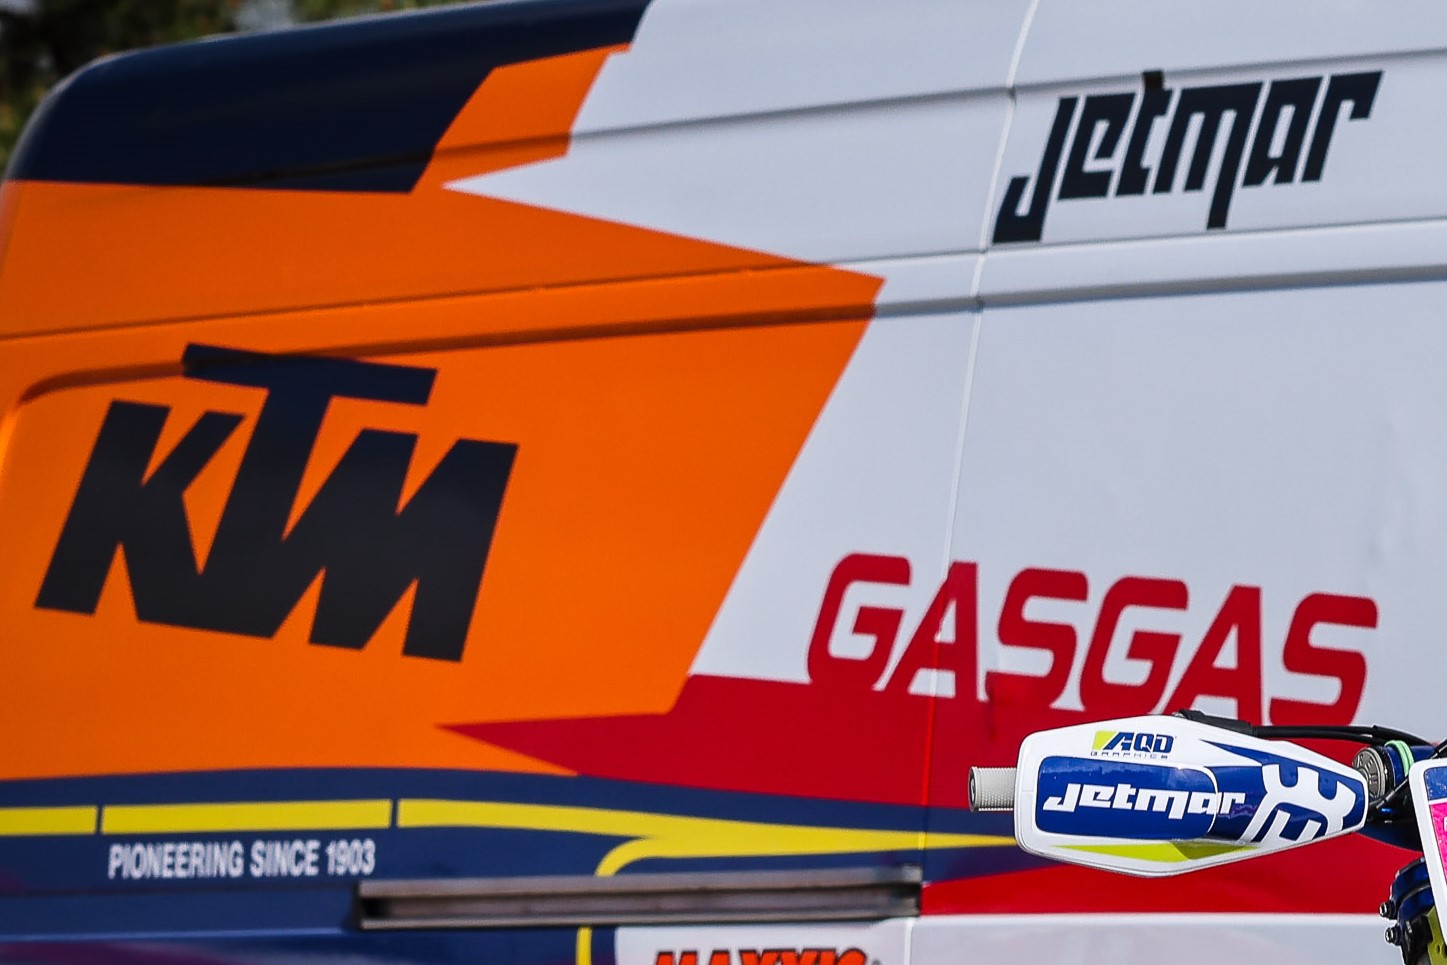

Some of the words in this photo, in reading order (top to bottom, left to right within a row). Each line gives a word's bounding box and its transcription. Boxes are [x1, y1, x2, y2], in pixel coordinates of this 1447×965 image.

[33, 343, 520, 663] KTM
[806, 552, 1379, 727] GASGAS
[107, 840, 245, 880] PIONEERING
[250, 838, 321, 878] SINCE
[325, 837, 377, 877] 1903
